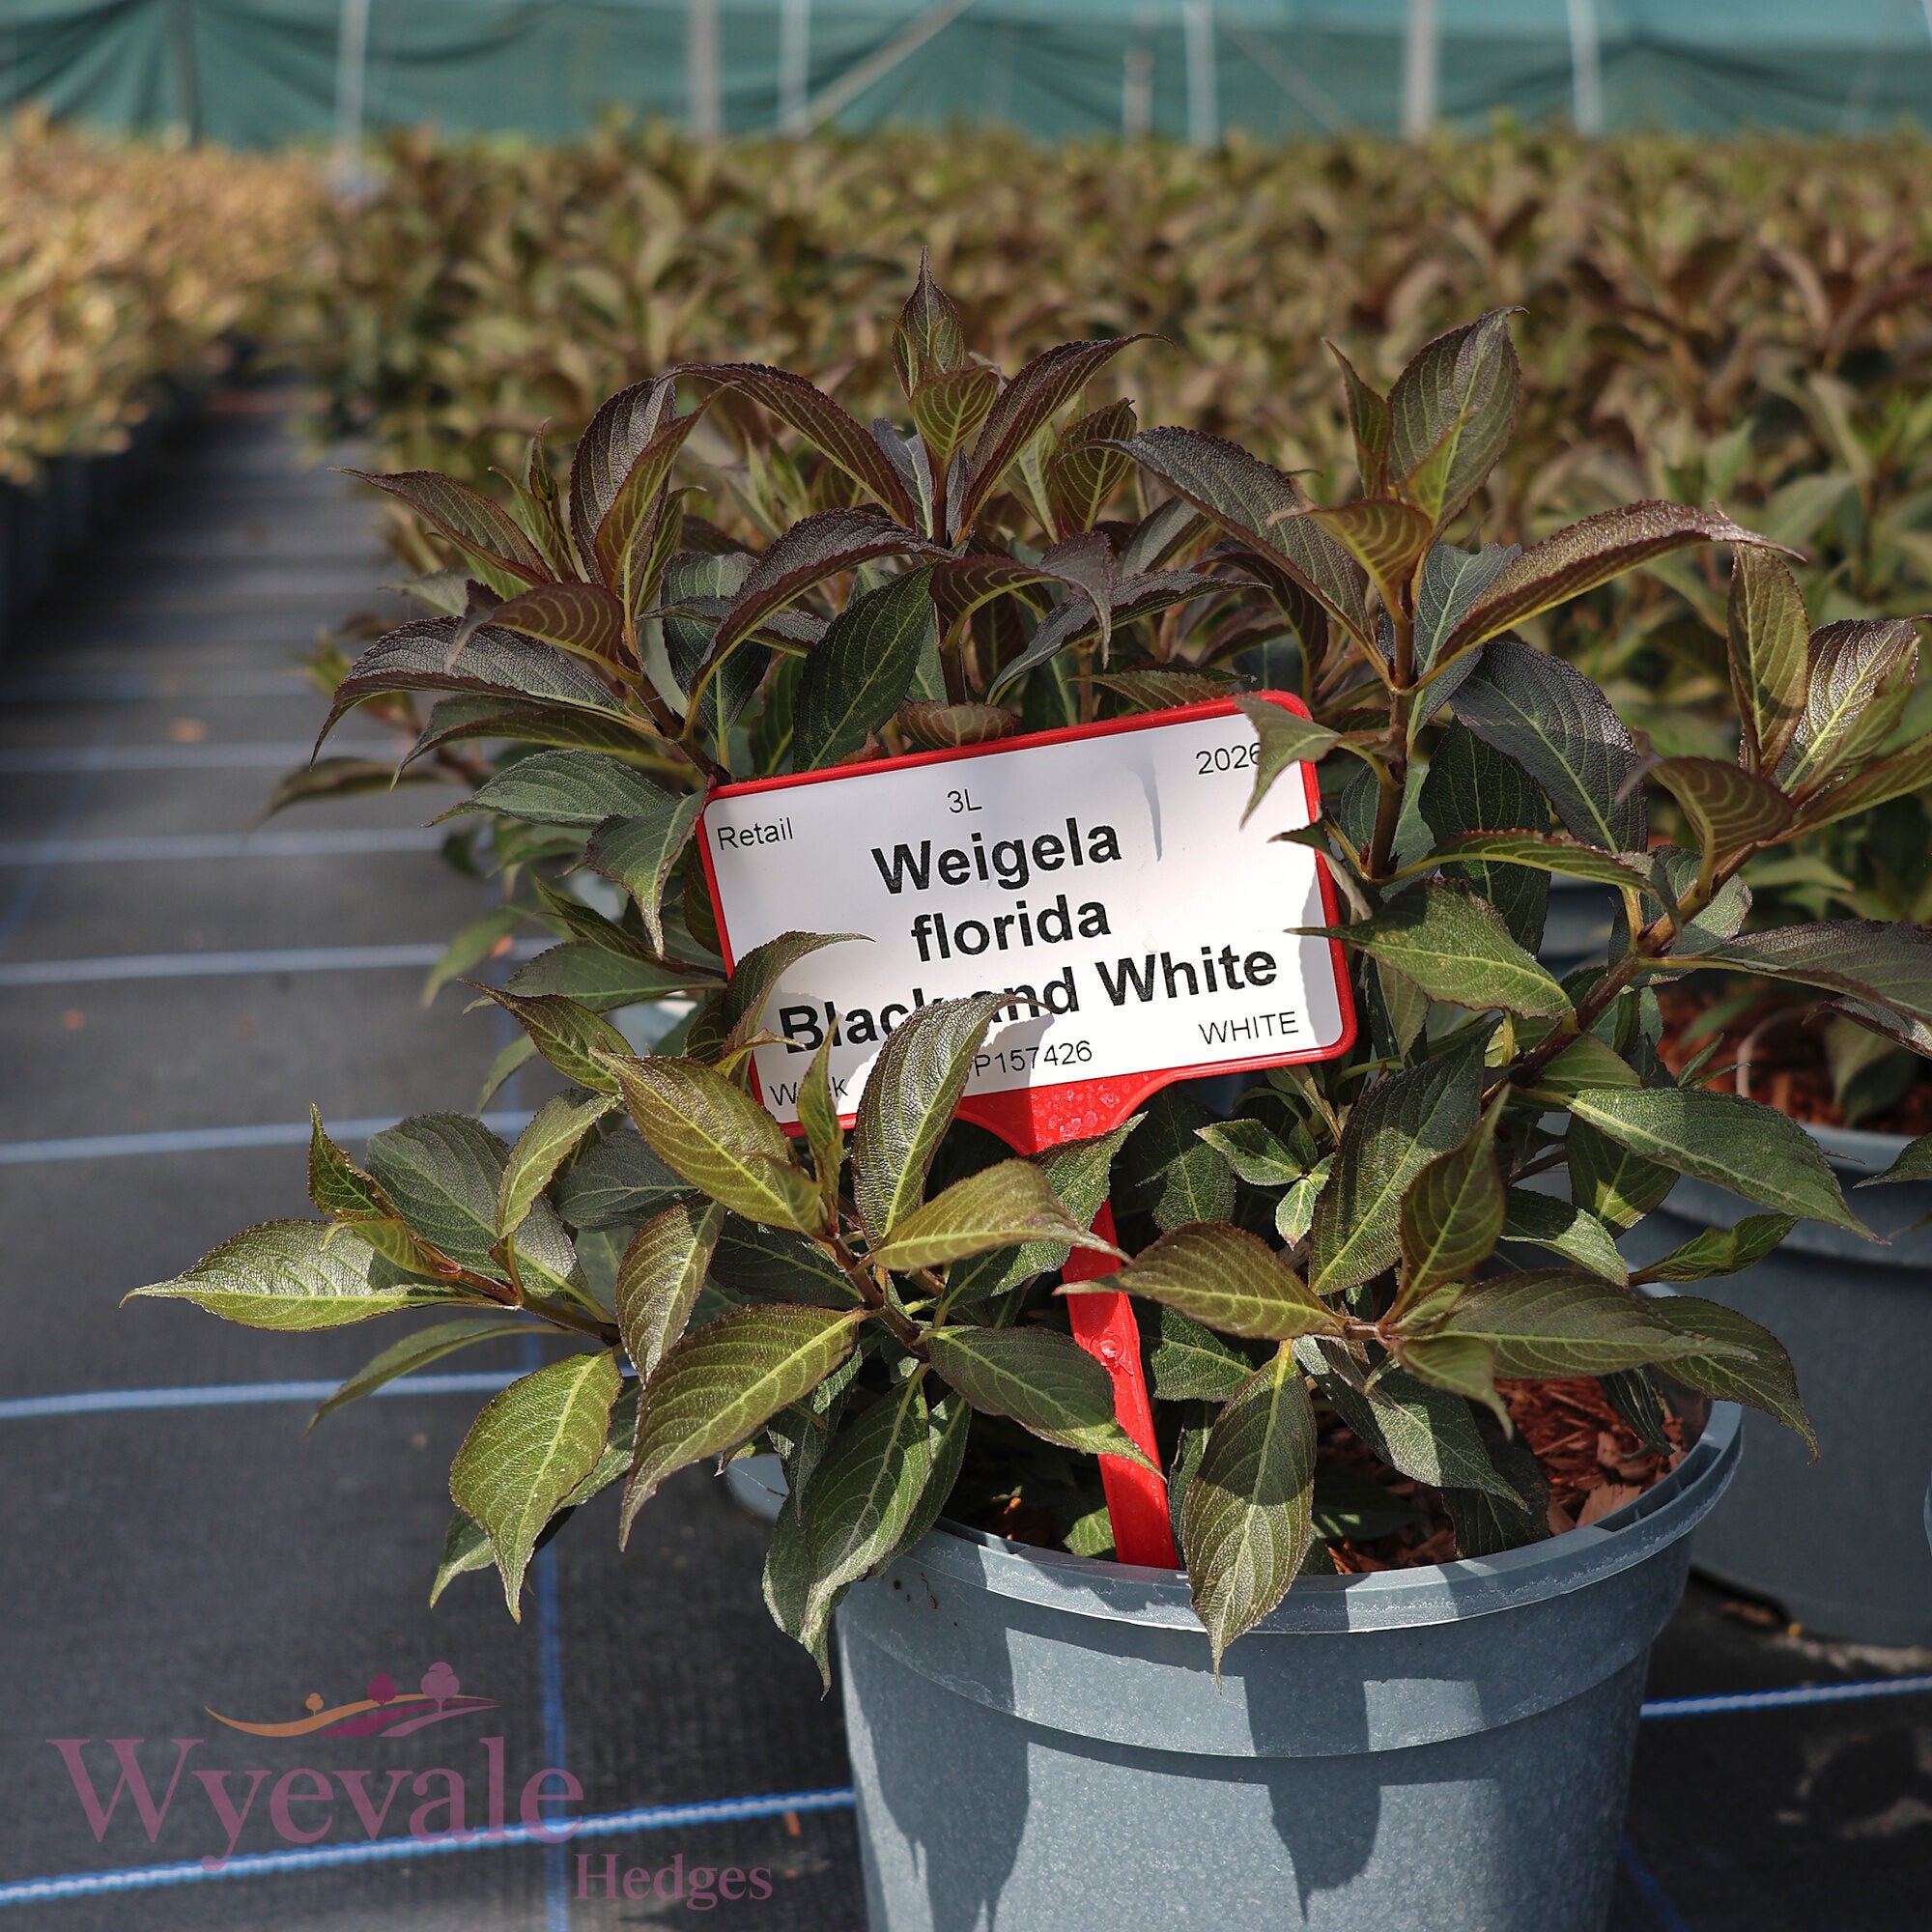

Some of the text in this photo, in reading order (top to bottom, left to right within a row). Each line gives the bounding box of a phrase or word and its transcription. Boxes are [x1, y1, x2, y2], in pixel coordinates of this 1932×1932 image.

[947, 788, 983, 814] 3L
[717, 816, 794, 851] Retail
[870, 817, 1122, 895] Weigela
[910, 894, 1112, 962] florida
[1094, 944, 1277, 1007] White
[1198, 1010, 1299, 1045] WHITE
[975, 1039, 1093, 1077] P157426
[769, 1075, 849, 1106] Wk
